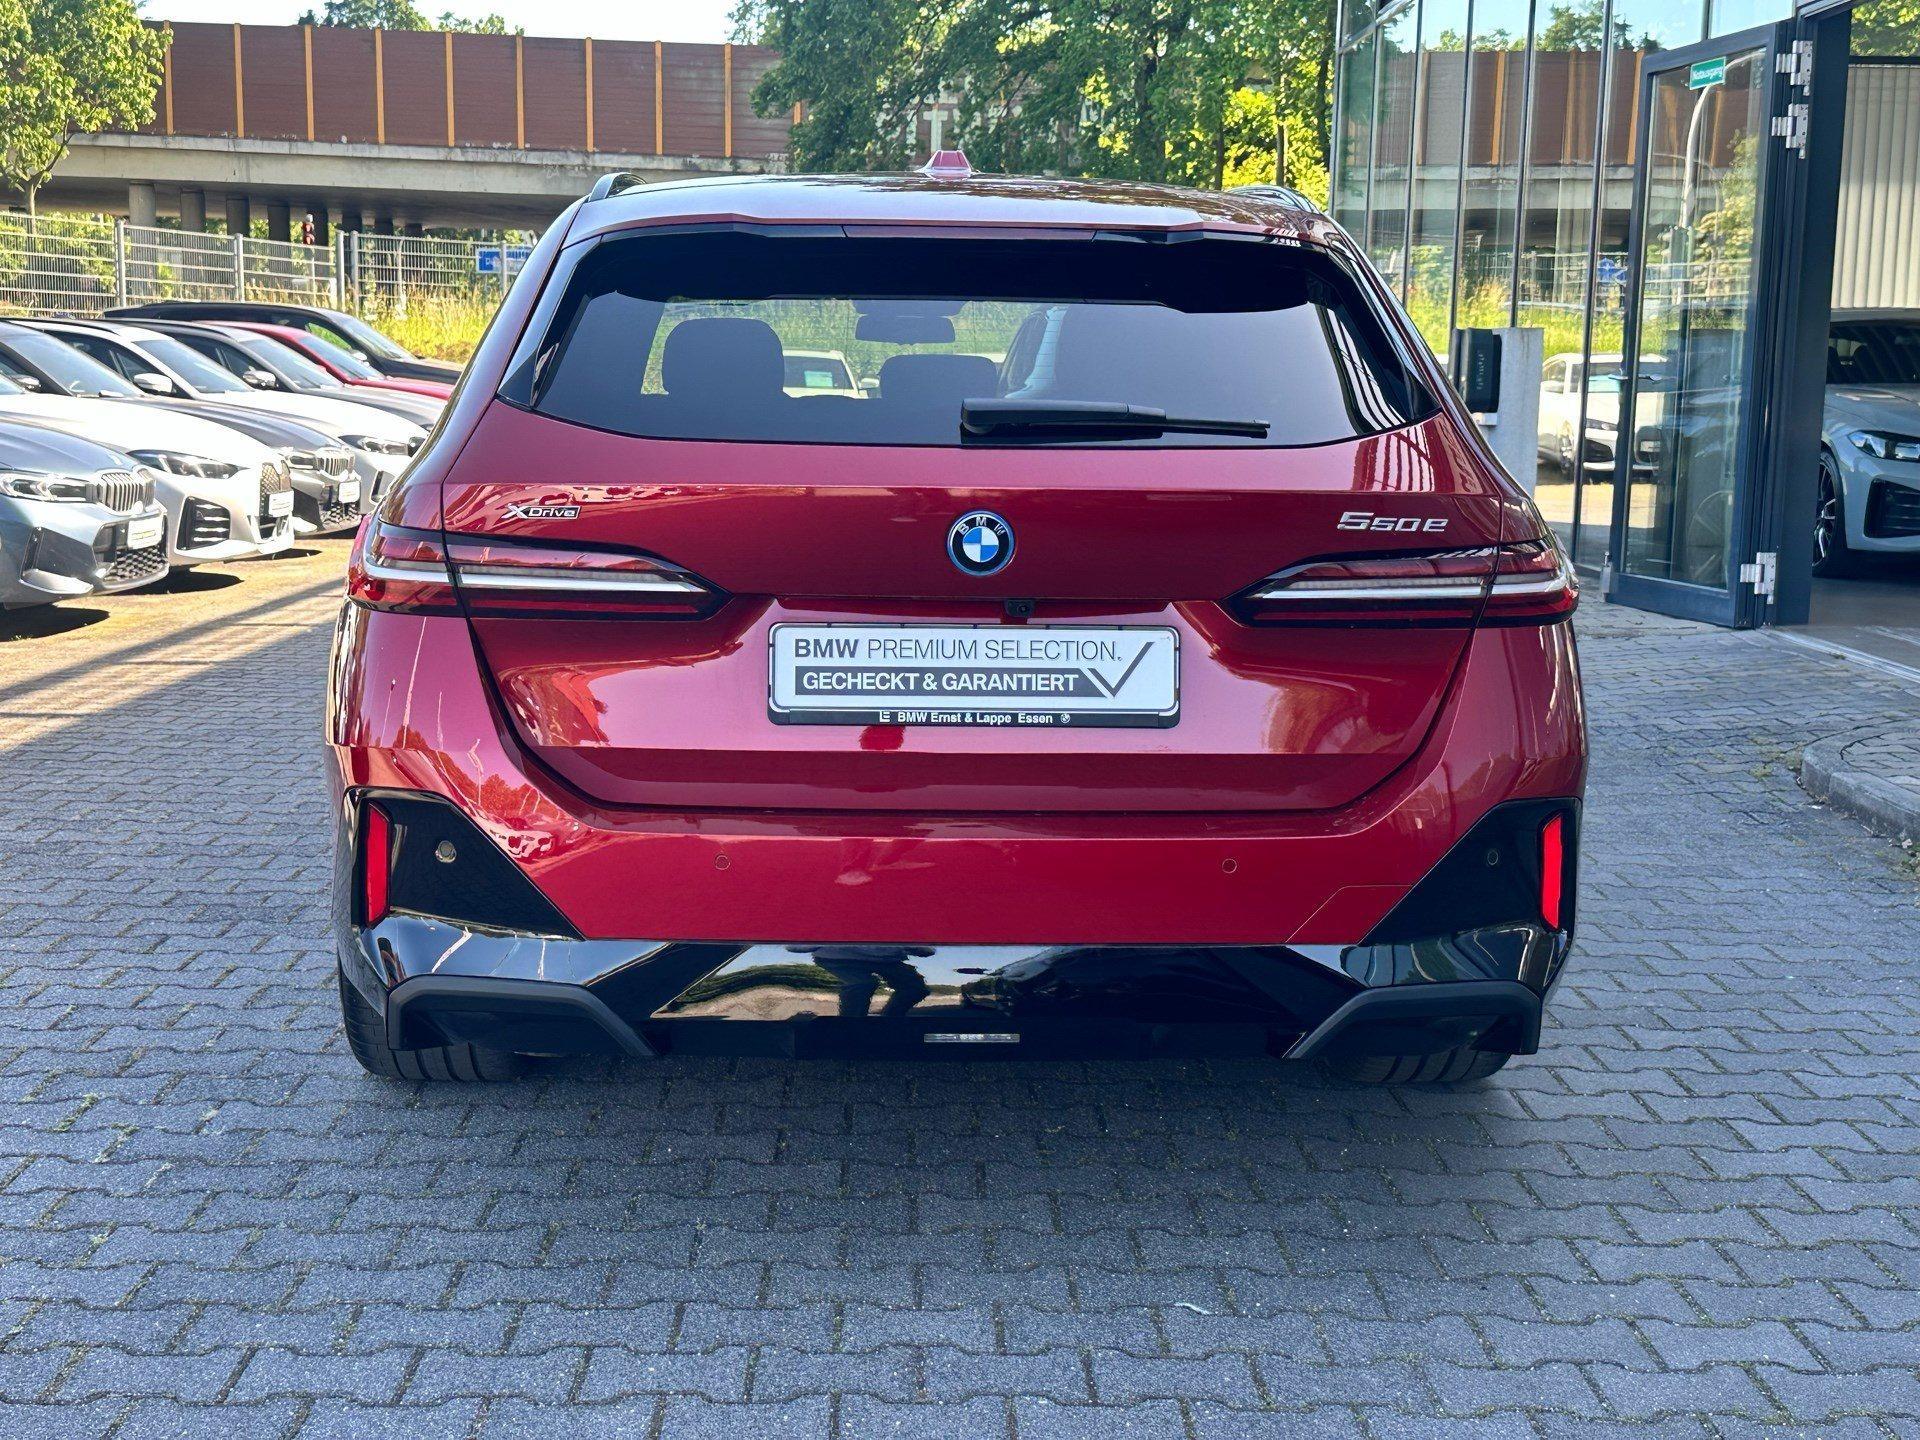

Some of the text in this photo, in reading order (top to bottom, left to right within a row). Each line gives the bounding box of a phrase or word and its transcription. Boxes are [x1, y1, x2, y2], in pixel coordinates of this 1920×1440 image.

[957, 515, 1006, 536] BMW
[794, 638, 860, 658] BMW
[867, 638, 978, 660] PREMIUM
[802, 671, 1080, 692] GECHECKT & GARANTIERT
[897, 711, 928, 723] BMW
[930, 711, 962, 723] Ernst
[964, 711, 974, 723] &
[976, 712, 1012, 726] Lappe
[1017, 712, 1054, 724] Essen
